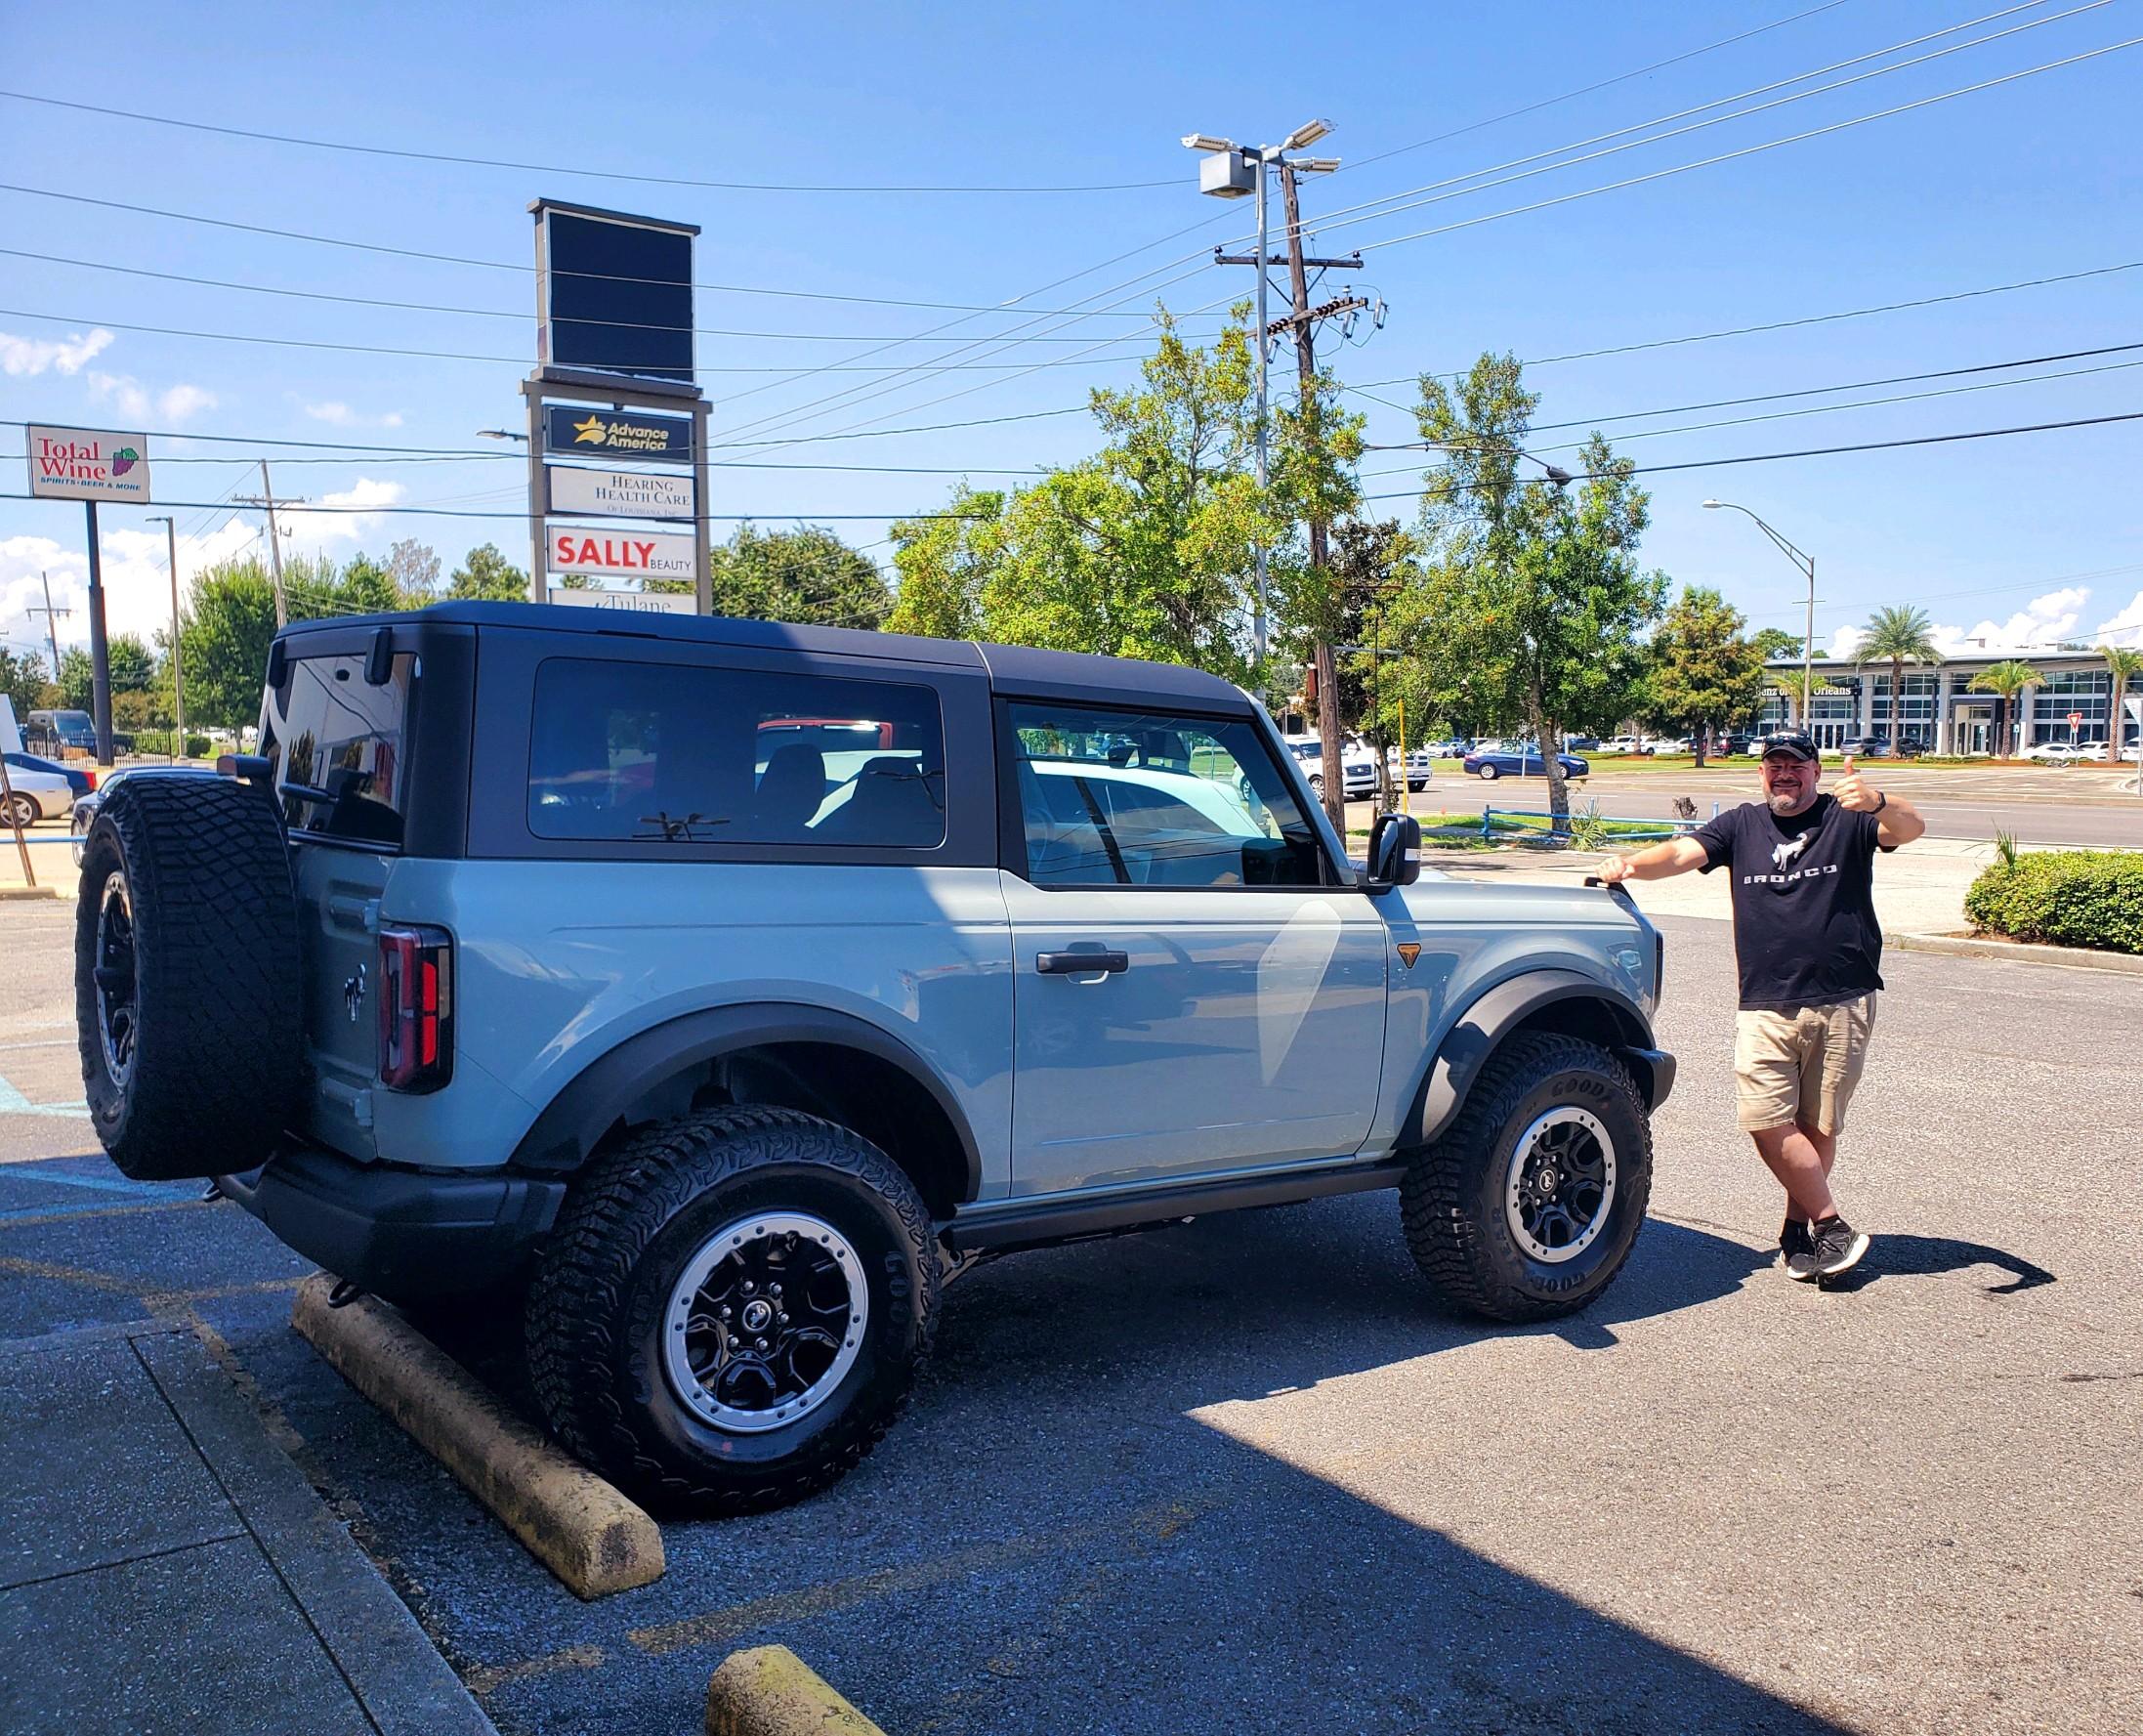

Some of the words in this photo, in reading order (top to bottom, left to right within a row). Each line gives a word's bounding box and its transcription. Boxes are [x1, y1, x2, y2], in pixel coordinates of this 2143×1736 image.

[608, 422, 669, 440] Advance
[38, 438, 100, 460] Total
[607, 434, 667, 450] America
[40, 457, 106, 481] Wine
[612, 476, 674, 491] HEARING
[596, 487, 651, 503] HEALTH
[653, 491, 691, 506] CARE
[557, 536, 656, 568] SALLY
[651, 559, 692, 571] BEAUTY
[1813, 686, 1851, 696] Orleans
[1744, 865, 1837, 884] BRONCO
